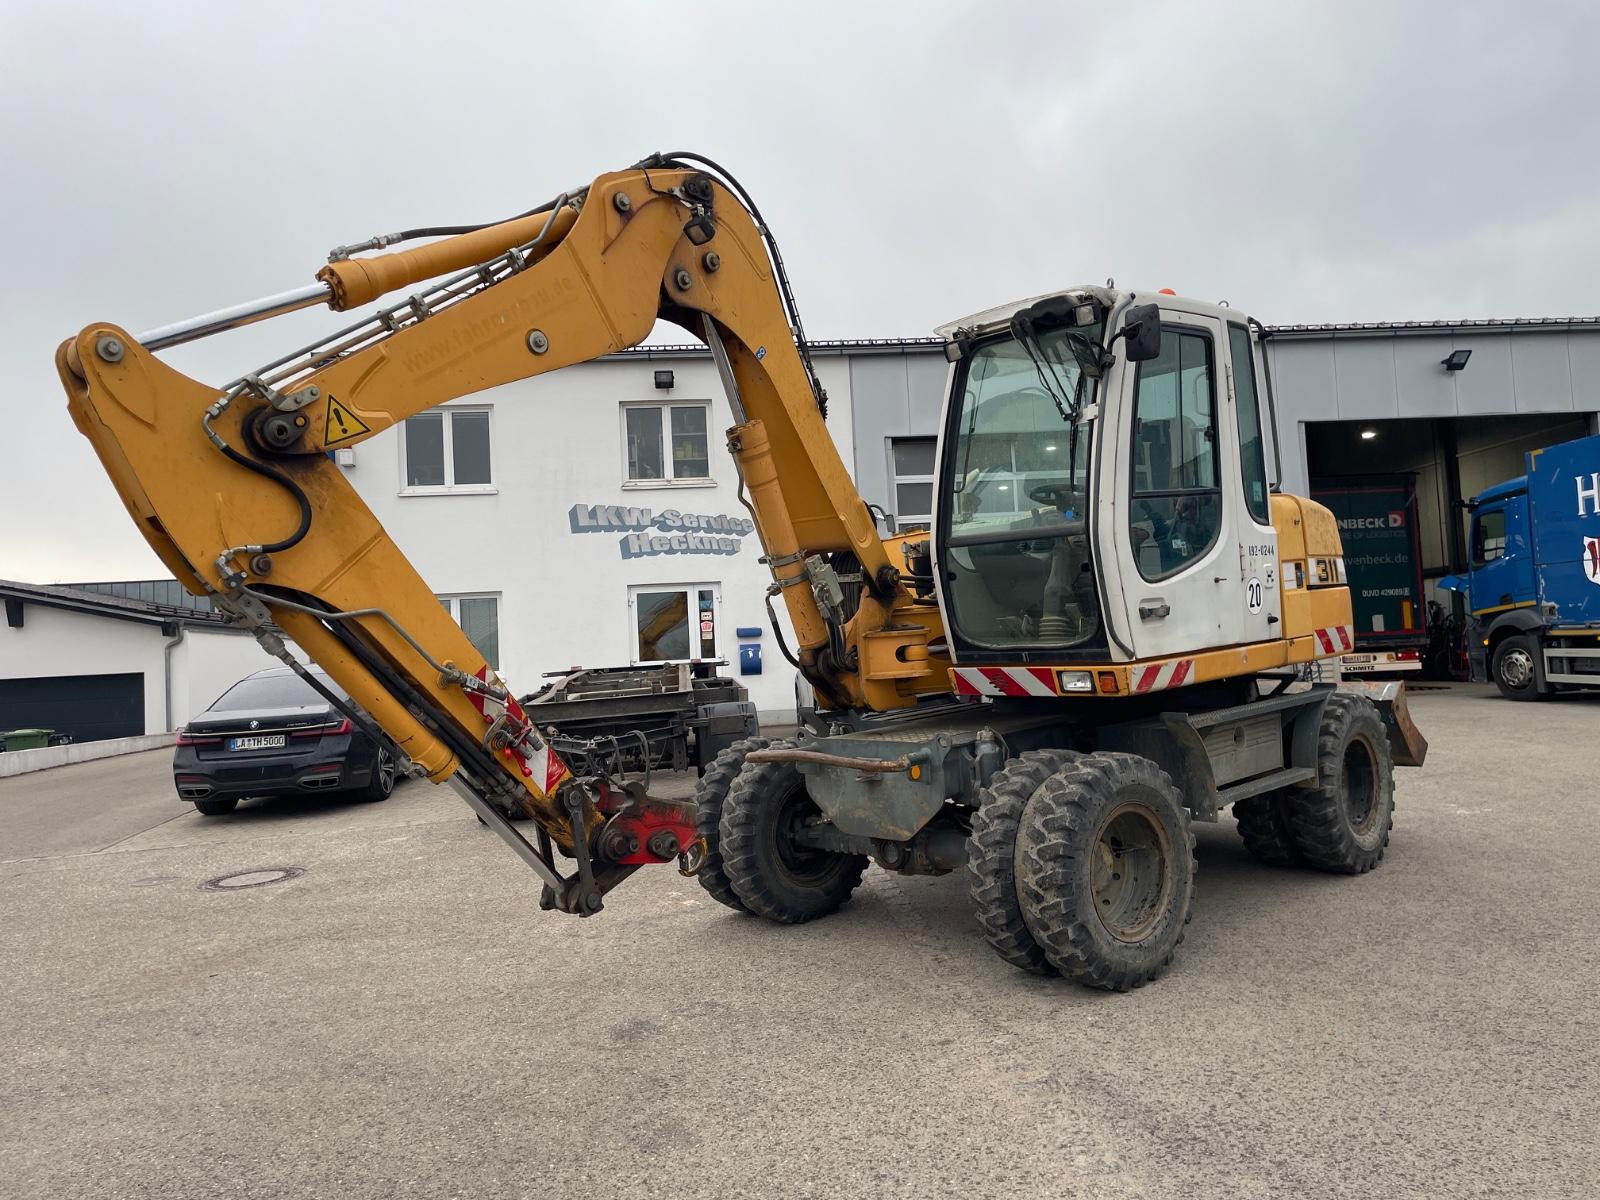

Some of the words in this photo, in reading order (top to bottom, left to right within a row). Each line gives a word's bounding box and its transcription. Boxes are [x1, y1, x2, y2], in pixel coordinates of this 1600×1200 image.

[570, 504, 755, 536] LKW-Service
[620, 533, 742, 558] Heckner
[1248, 583, 1261, 608] 20
[235, 739, 246, 748] LA
[252, 738, 263, 747] TH
[264, 736, 285, 746] 5000
